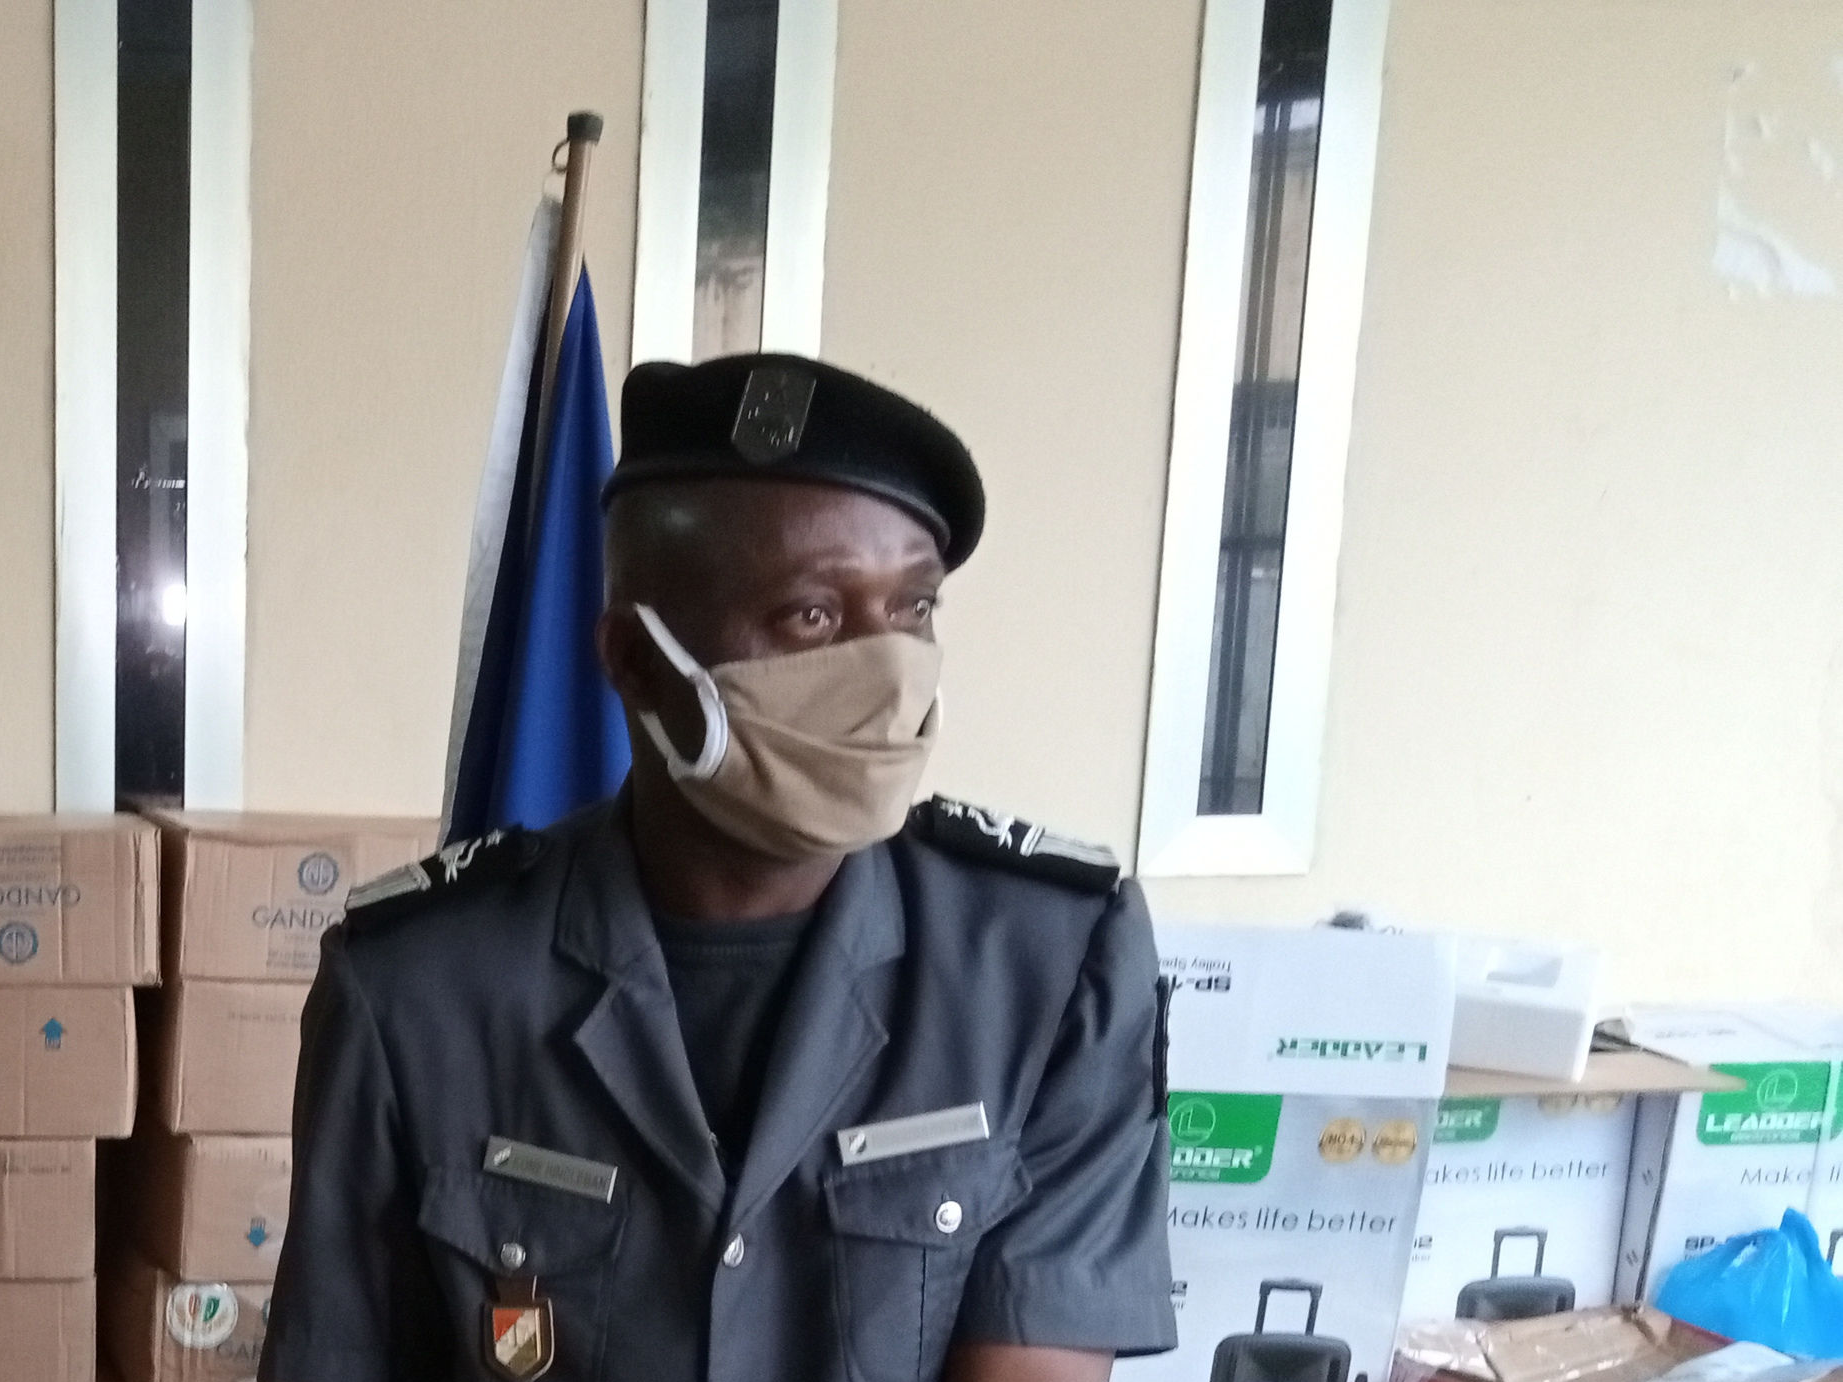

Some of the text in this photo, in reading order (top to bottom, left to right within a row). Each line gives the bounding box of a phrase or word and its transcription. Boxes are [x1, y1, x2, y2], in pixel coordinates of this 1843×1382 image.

[1274, 1036, 1428, 1064] LEADDER
[1487, 1160, 1524, 1182] life
[1531, 1159, 1608, 1181] better
[1255, 1206, 1299, 1232] life
[1306, 1208, 1397, 1234] better
